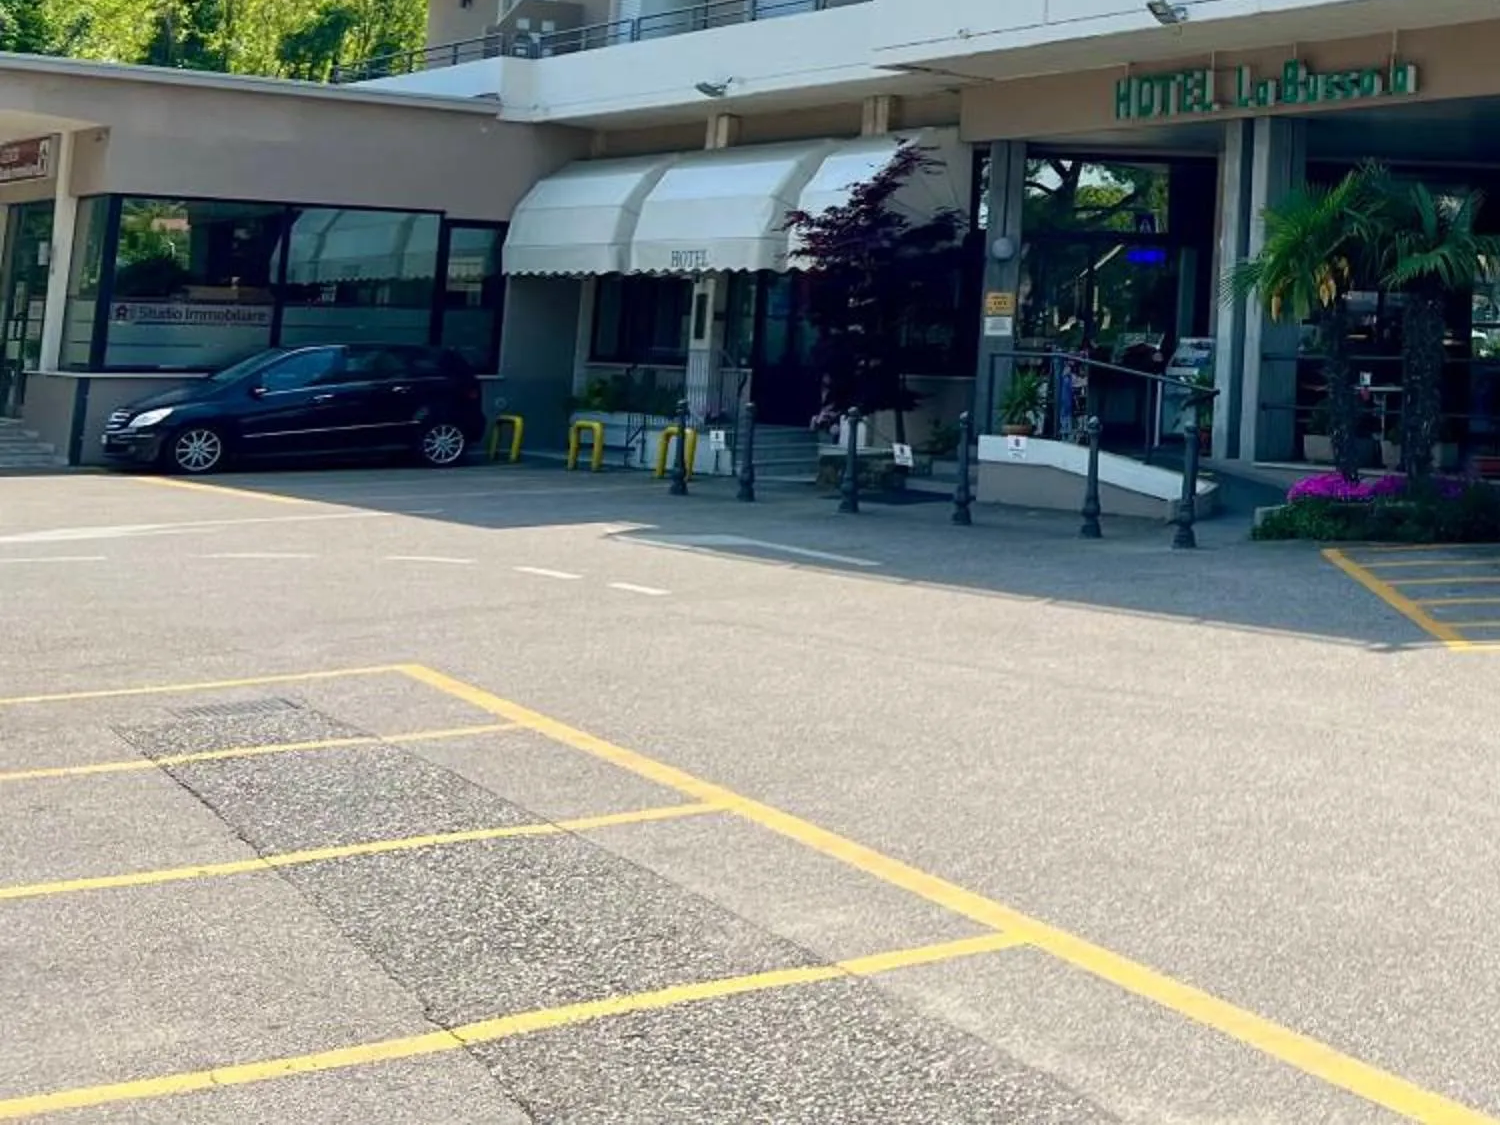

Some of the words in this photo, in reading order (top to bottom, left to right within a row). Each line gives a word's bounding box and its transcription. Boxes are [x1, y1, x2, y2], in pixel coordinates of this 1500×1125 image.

[1116, 68, 1218, 119] HOTEL
[1236, 62, 1277, 107] La
[1282, 58, 1417, 104] Bussoa
[671, 250, 710, 268] HOTEL
[137, 304, 182, 320] Studio
[184, 306, 268, 323] Immobiliare
